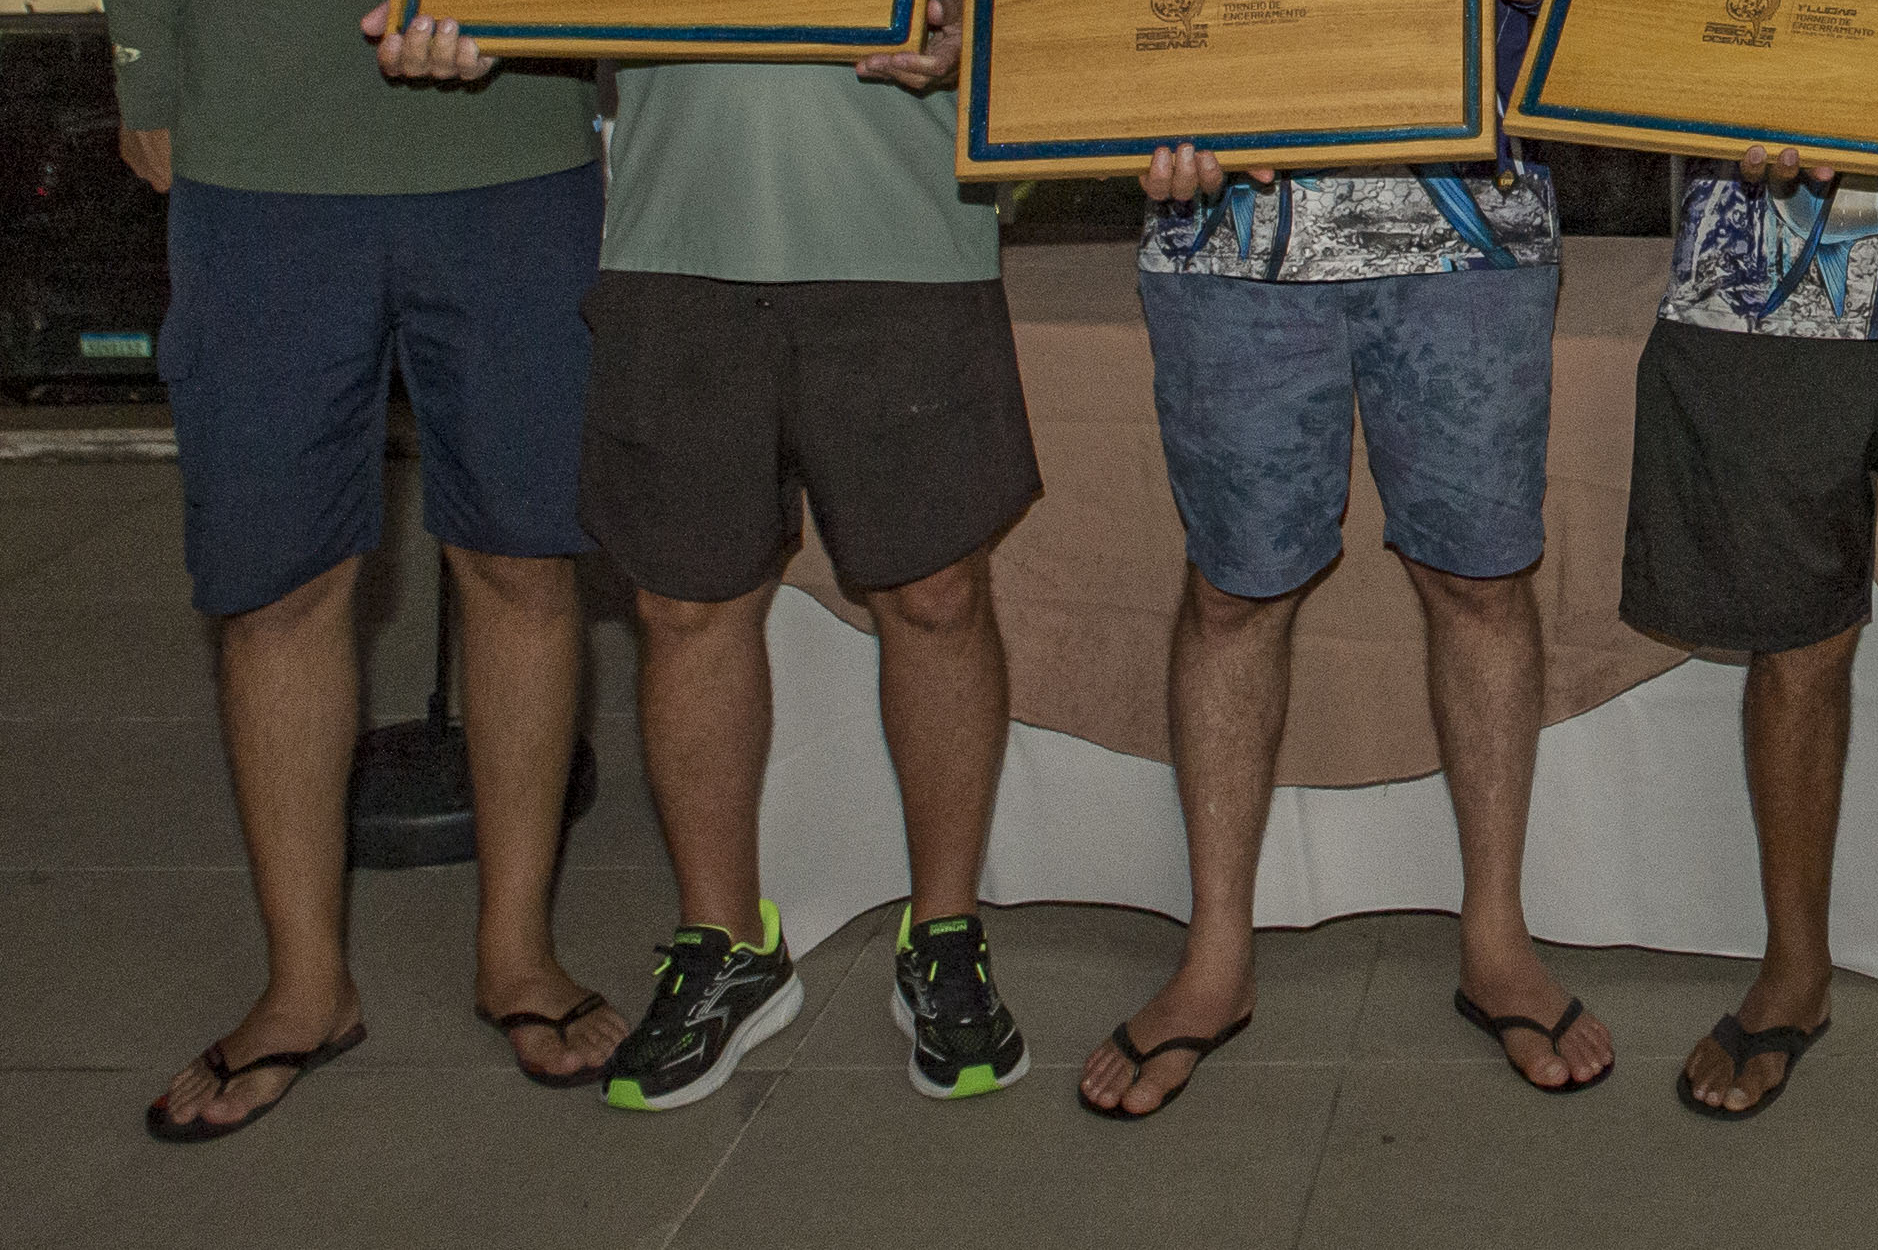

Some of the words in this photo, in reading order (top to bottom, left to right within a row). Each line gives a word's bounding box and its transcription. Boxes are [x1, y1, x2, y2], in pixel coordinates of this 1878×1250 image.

[1223, 1, 1267, 12] TORNEIO
[1269, 0, 1281, 10] DE
[1223, 8, 1307, 21] ENCERRAMENTO
[1795, 13, 1837, 25] TORNEIO
[1838, 17, 1852, 26] DE
[1792, 21, 1875, 37] ENCERRAMENTO
